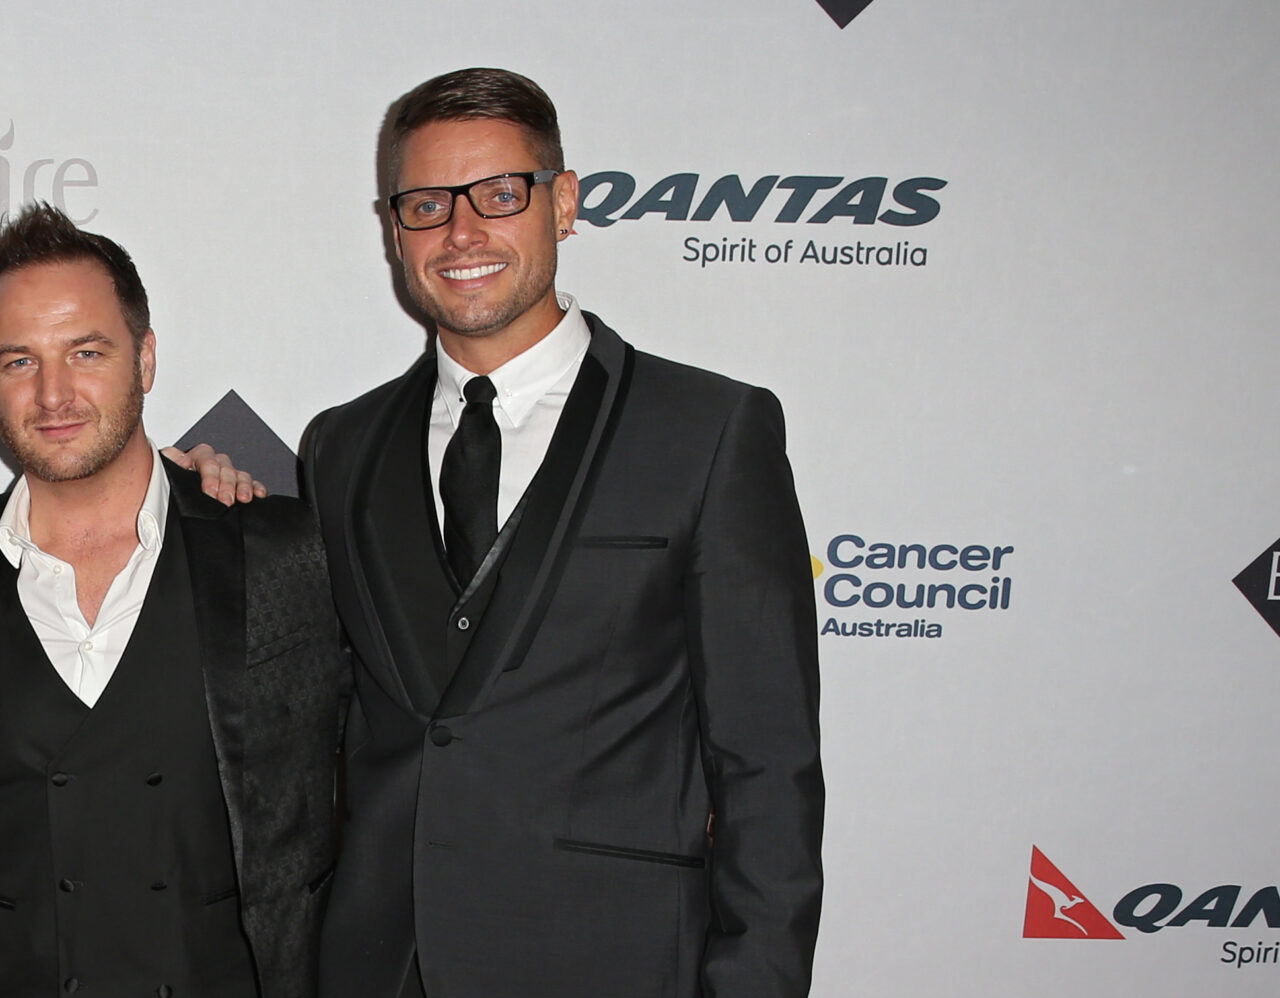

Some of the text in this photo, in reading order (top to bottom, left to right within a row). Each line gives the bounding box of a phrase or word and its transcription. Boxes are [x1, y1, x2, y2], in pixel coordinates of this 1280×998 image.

[576, 170, 949, 228] QANTAS
[682, 237, 928, 268] Spirit of Australia
[827, 534, 1015, 572] Cancer
[824, 573, 1012, 611] Council
[820, 617, 943, 639] Australia
